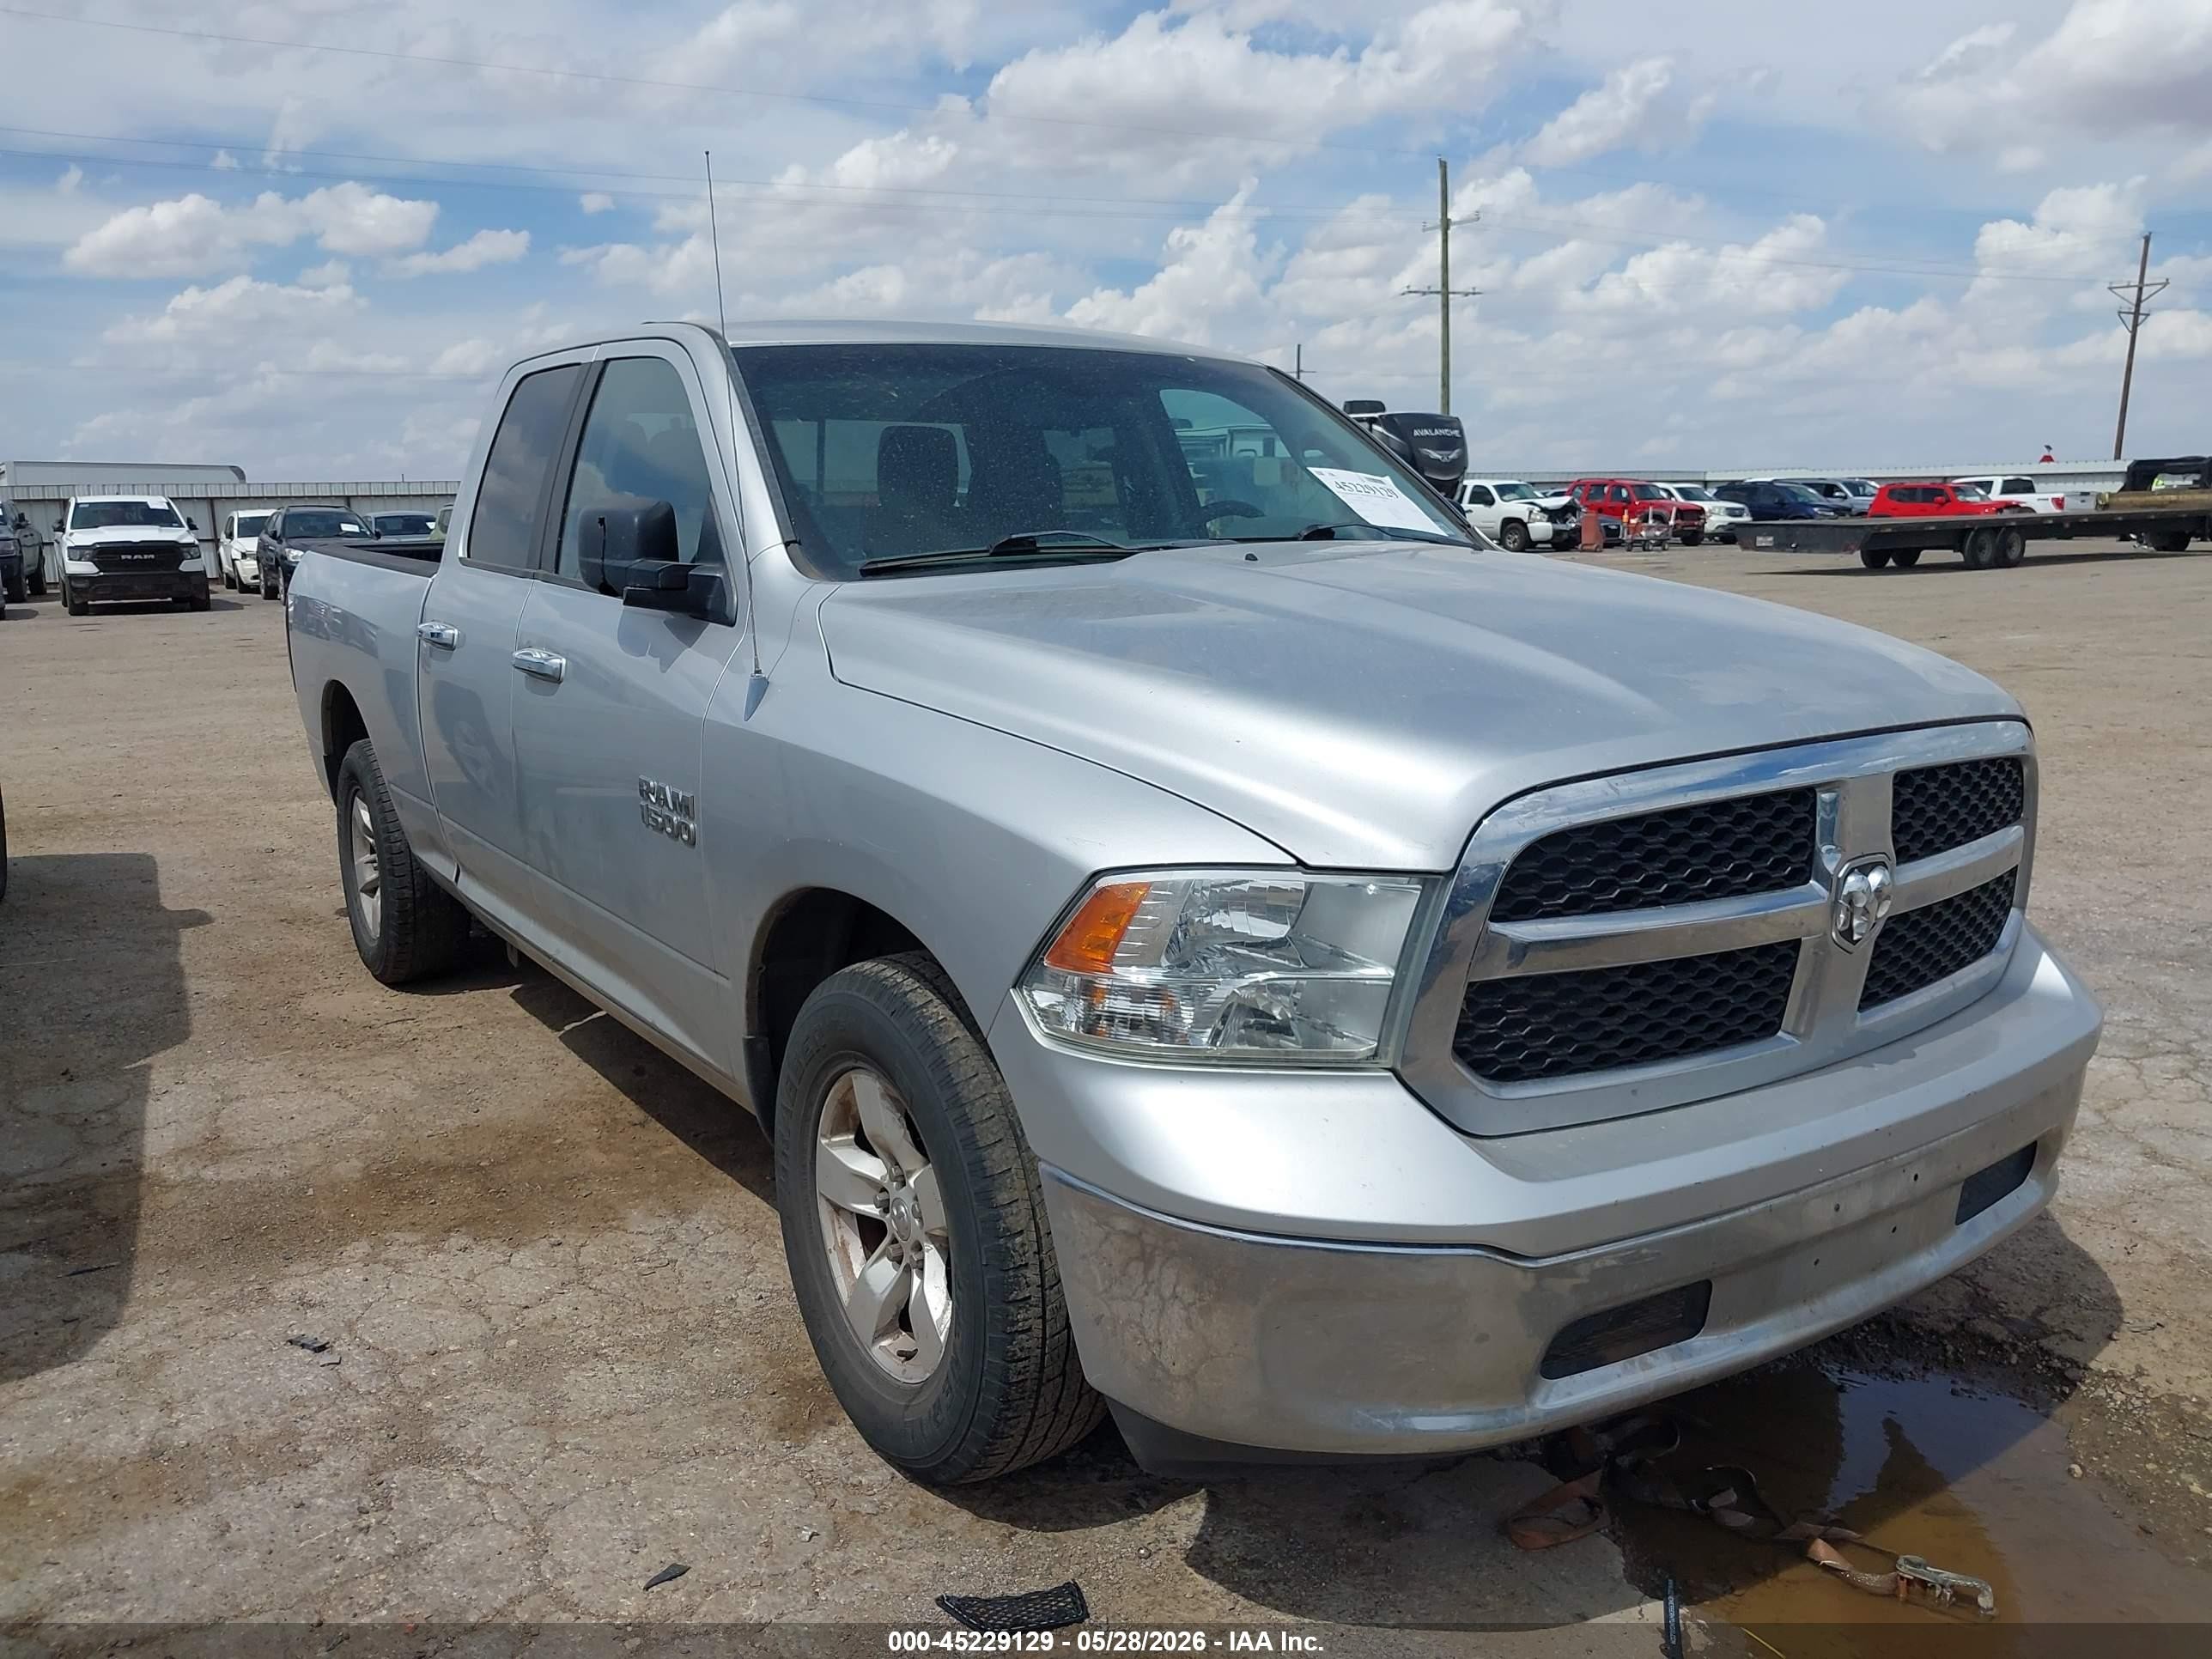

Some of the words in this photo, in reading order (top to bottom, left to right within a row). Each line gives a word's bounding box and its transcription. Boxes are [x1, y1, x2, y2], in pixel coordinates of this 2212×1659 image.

[1413, 428, 1462, 438] AVALANCHE
[1333, 480, 1400, 500] 45229129
[638, 775, 696, 820] RAM
[640, 801, 696, 847] 1500
